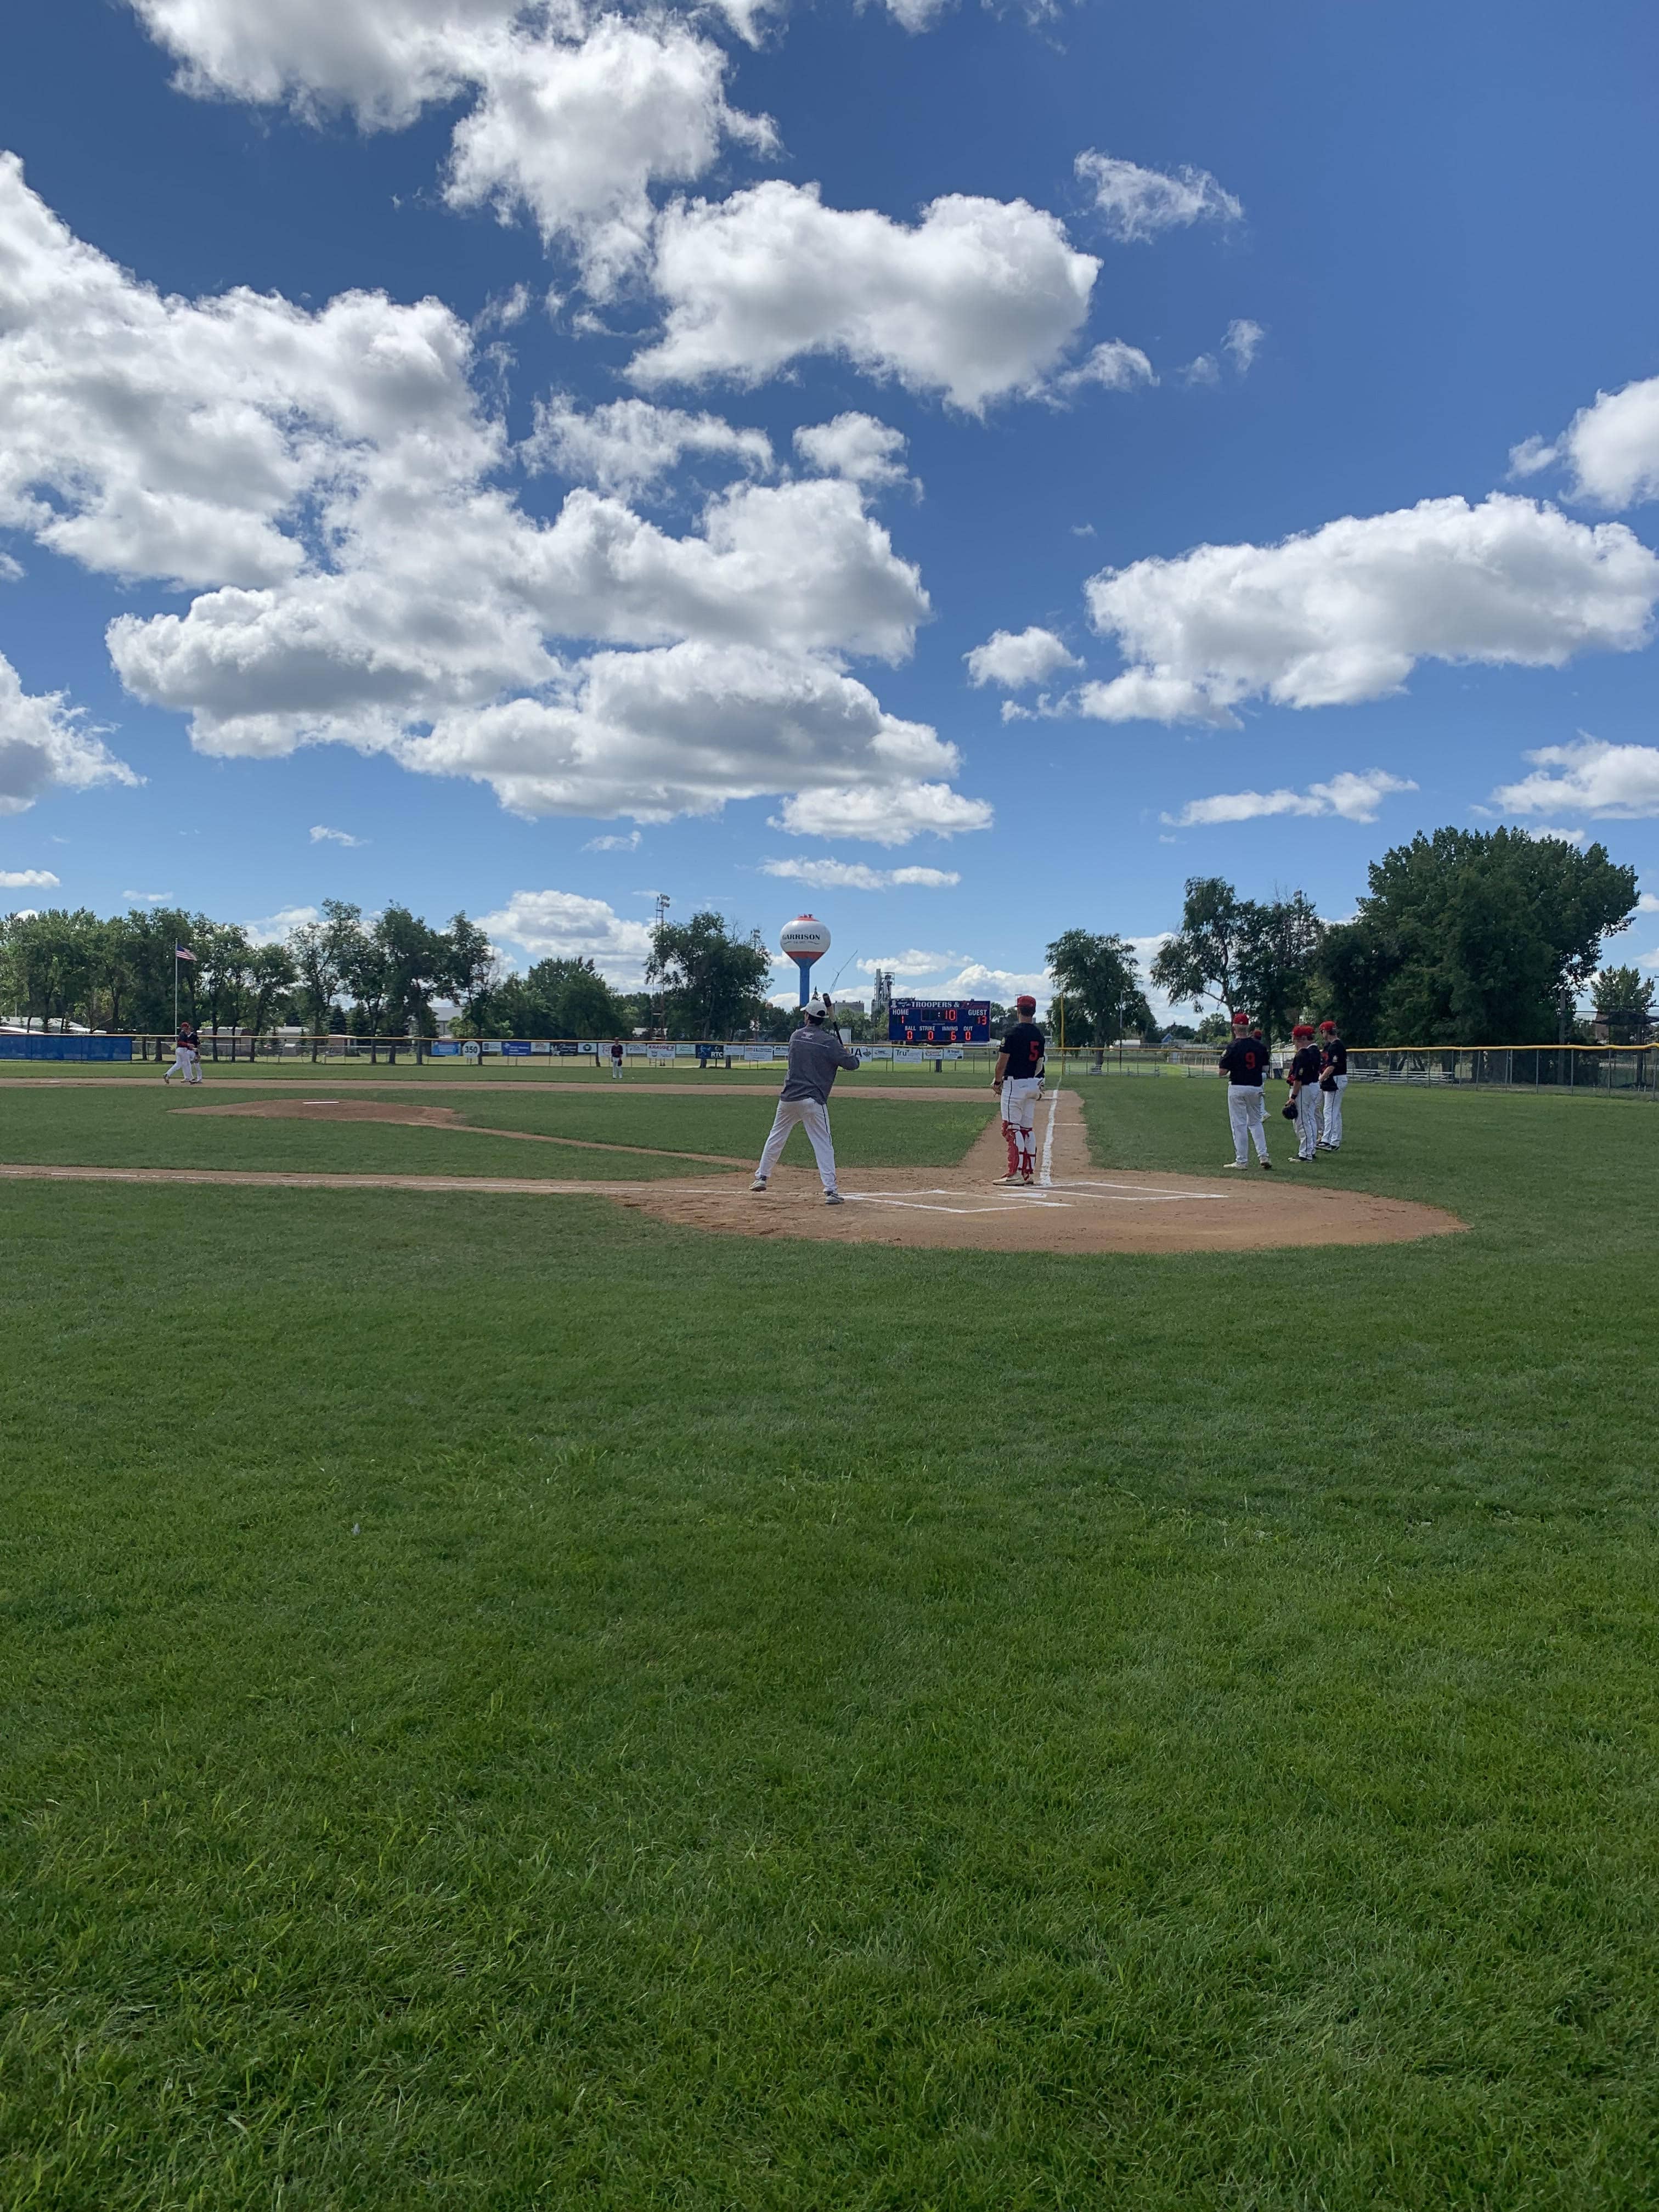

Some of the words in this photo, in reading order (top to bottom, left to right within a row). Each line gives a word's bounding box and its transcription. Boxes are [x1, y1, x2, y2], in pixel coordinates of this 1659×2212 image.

[978, 1015, 987, 1025] 13
[907, 1031, 913, 1040] 0
[928, 1031, 934, 1040] 0
[951, 1031, 956, 1040] 6
[965, 1031, 971, 1040] 0
[1029, 1041, 1039, 1061] 5
[1245, 1052, 1255, 1069] 9
